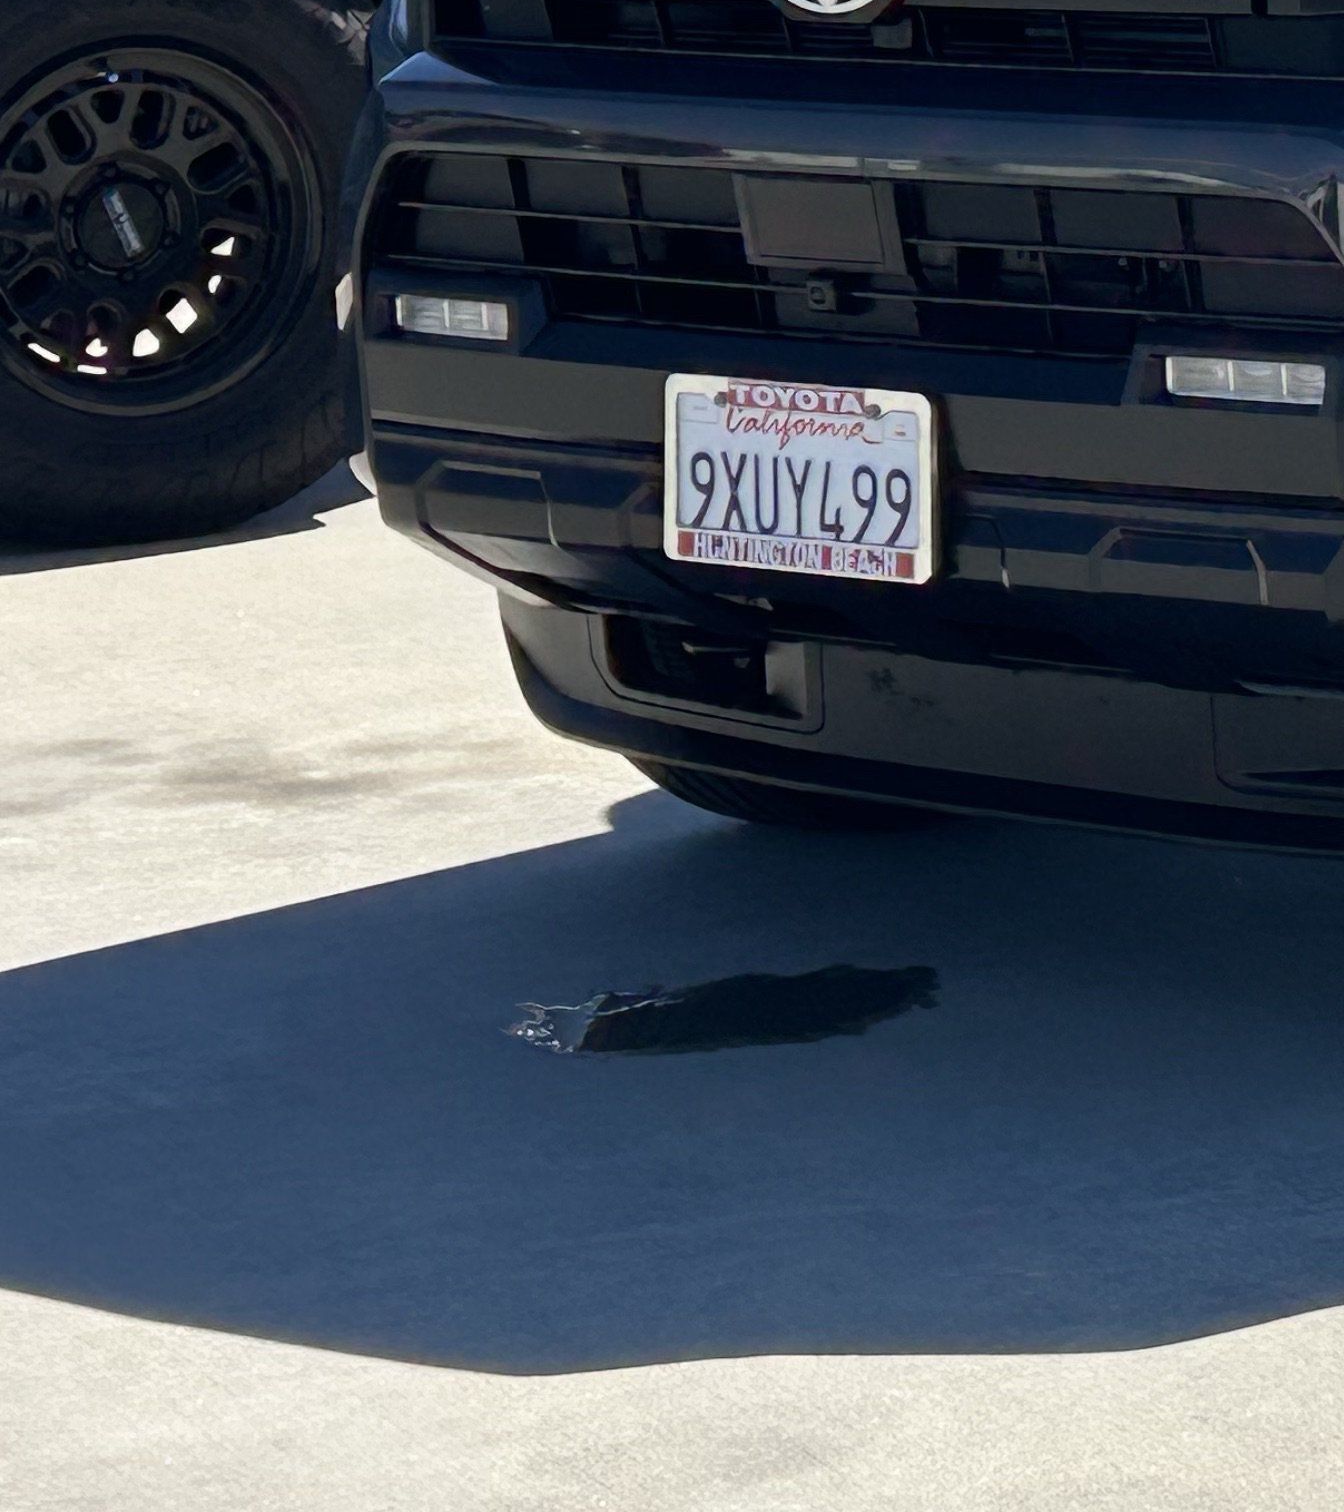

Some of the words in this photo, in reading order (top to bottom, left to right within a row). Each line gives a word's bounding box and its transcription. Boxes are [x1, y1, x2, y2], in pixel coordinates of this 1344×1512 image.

[729, 384, 864, 413] TOYOTA
[726, 406, 883, 449] California
[690, 451, 911, 546] 9XUY499
